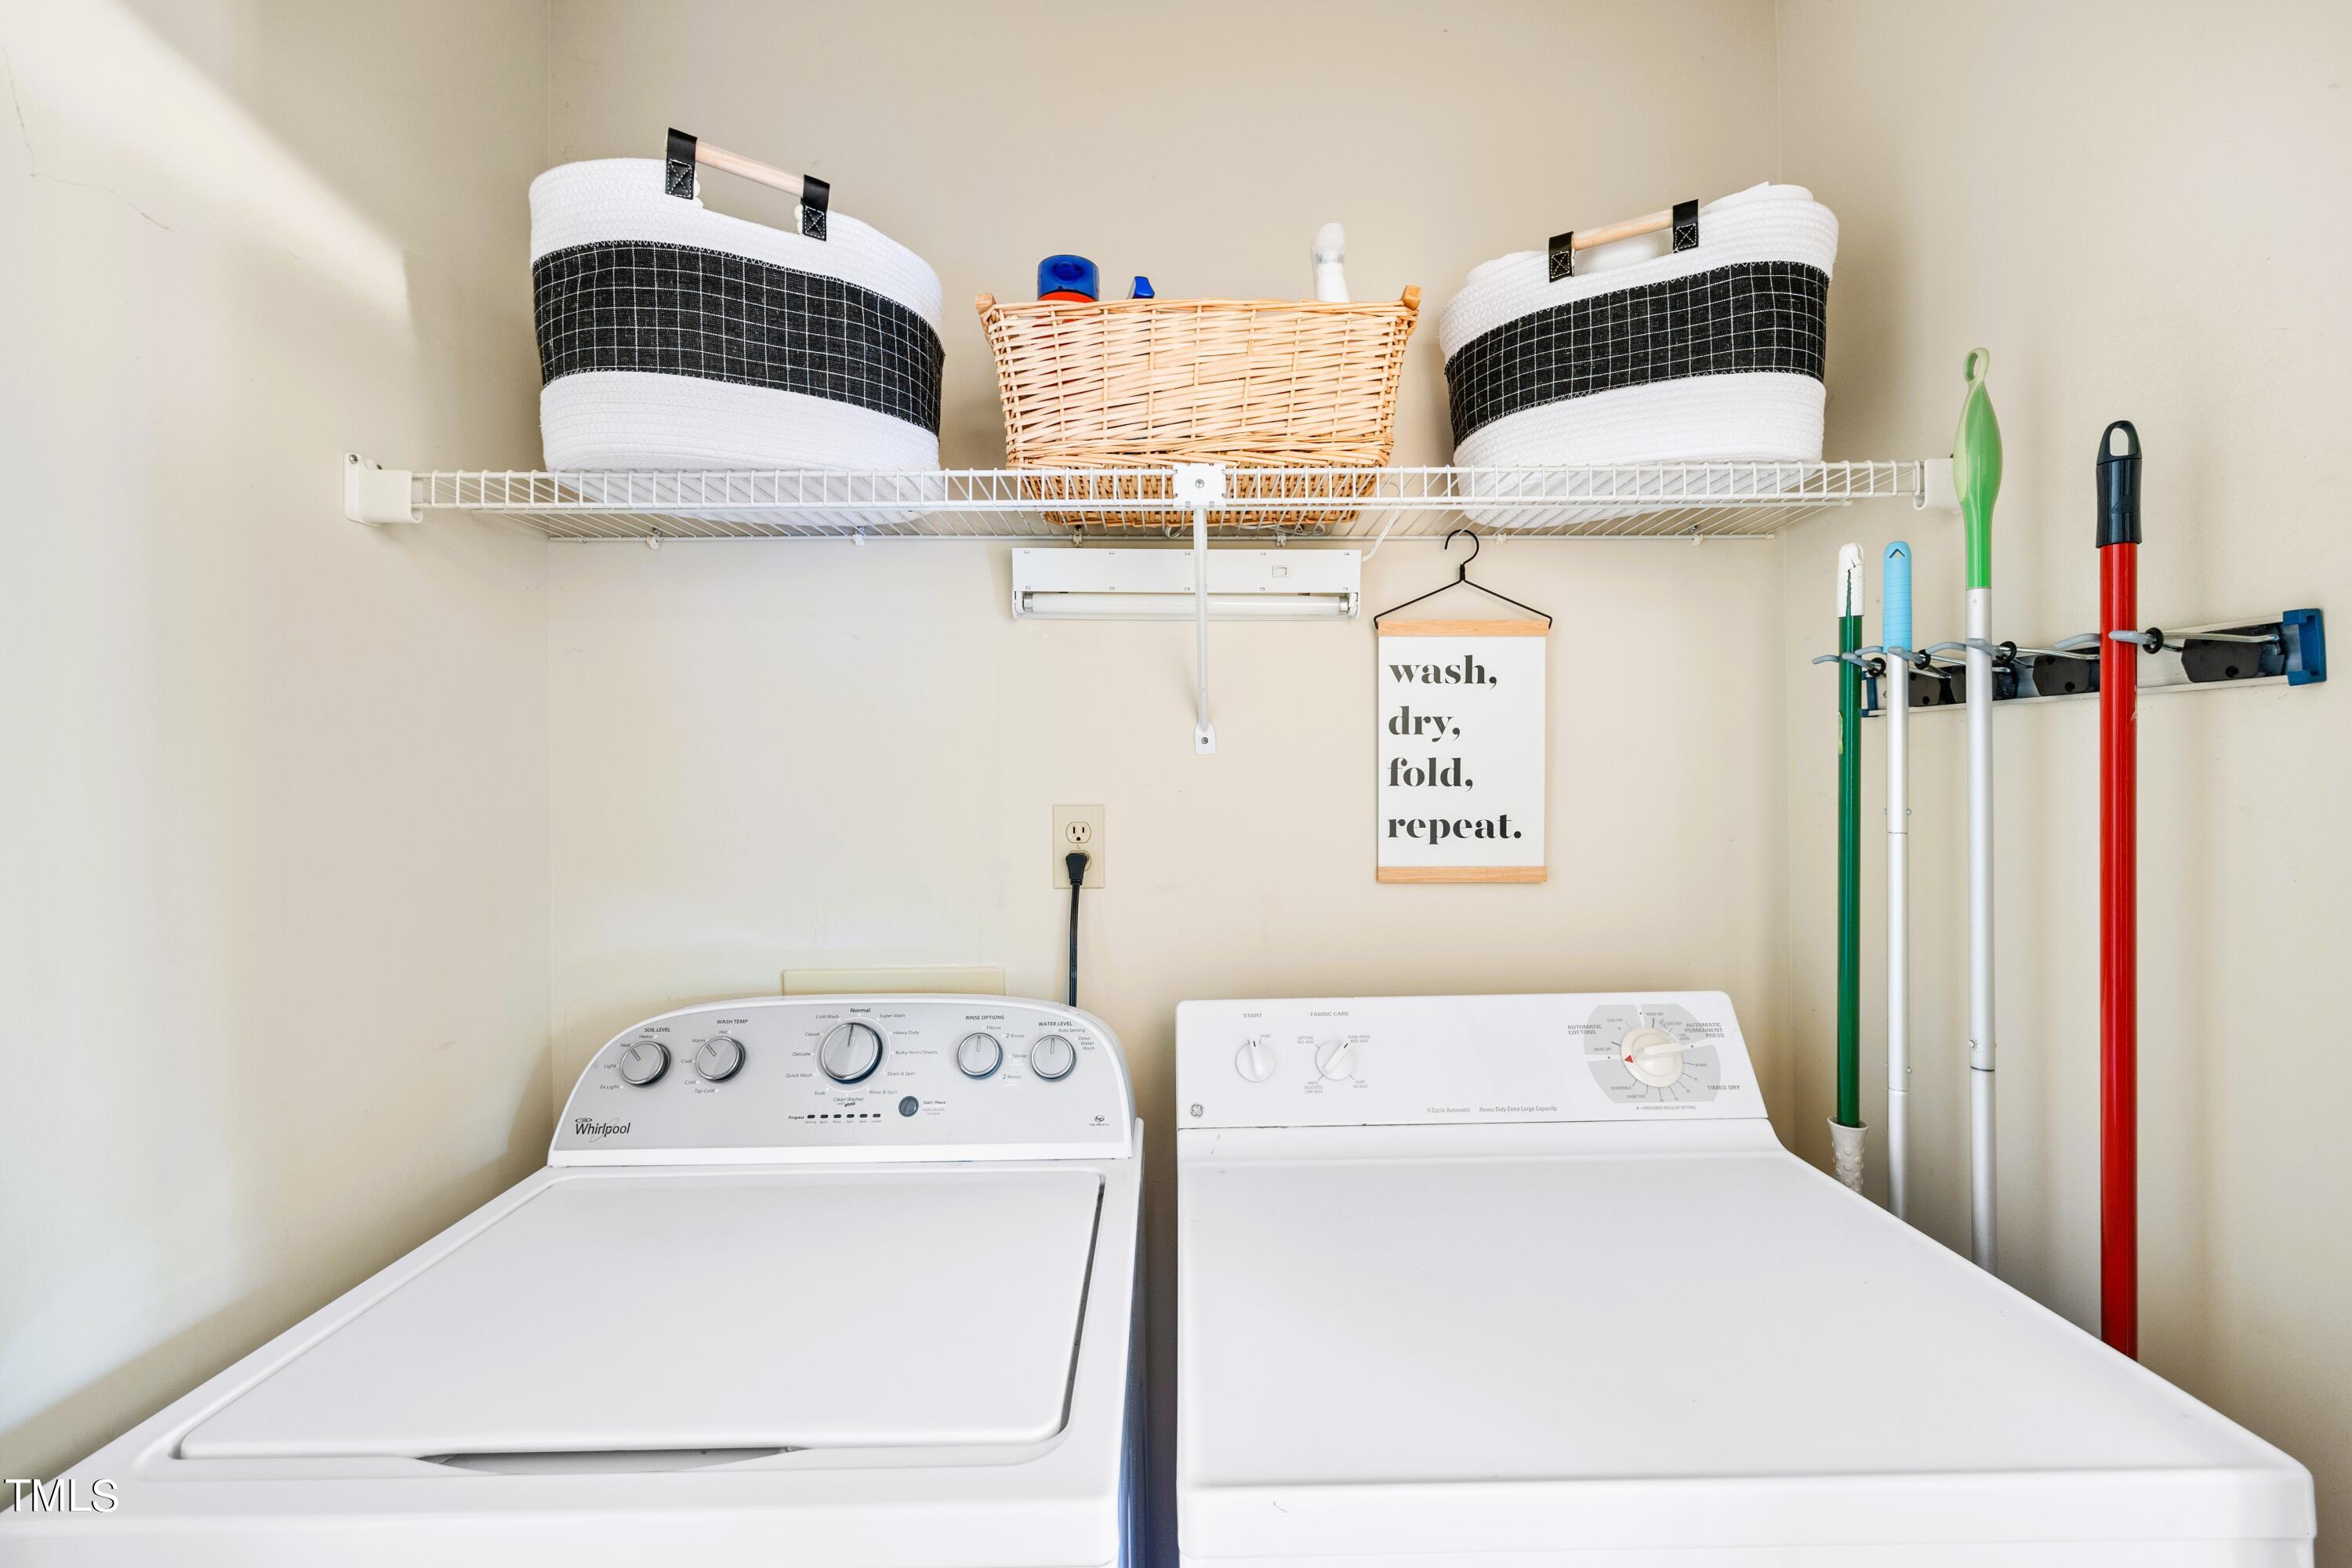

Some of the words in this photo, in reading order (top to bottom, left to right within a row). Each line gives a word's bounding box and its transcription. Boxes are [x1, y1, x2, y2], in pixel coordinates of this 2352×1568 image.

[1388, 655, 1497, 690] wash,
[1388, 706, 1461, 742] dry,
[1388, 757, 1473, 793] fold,
[1387, 814, 1522, 844] repeat.
[575, 1123, 631, 1138] Whirlpool
